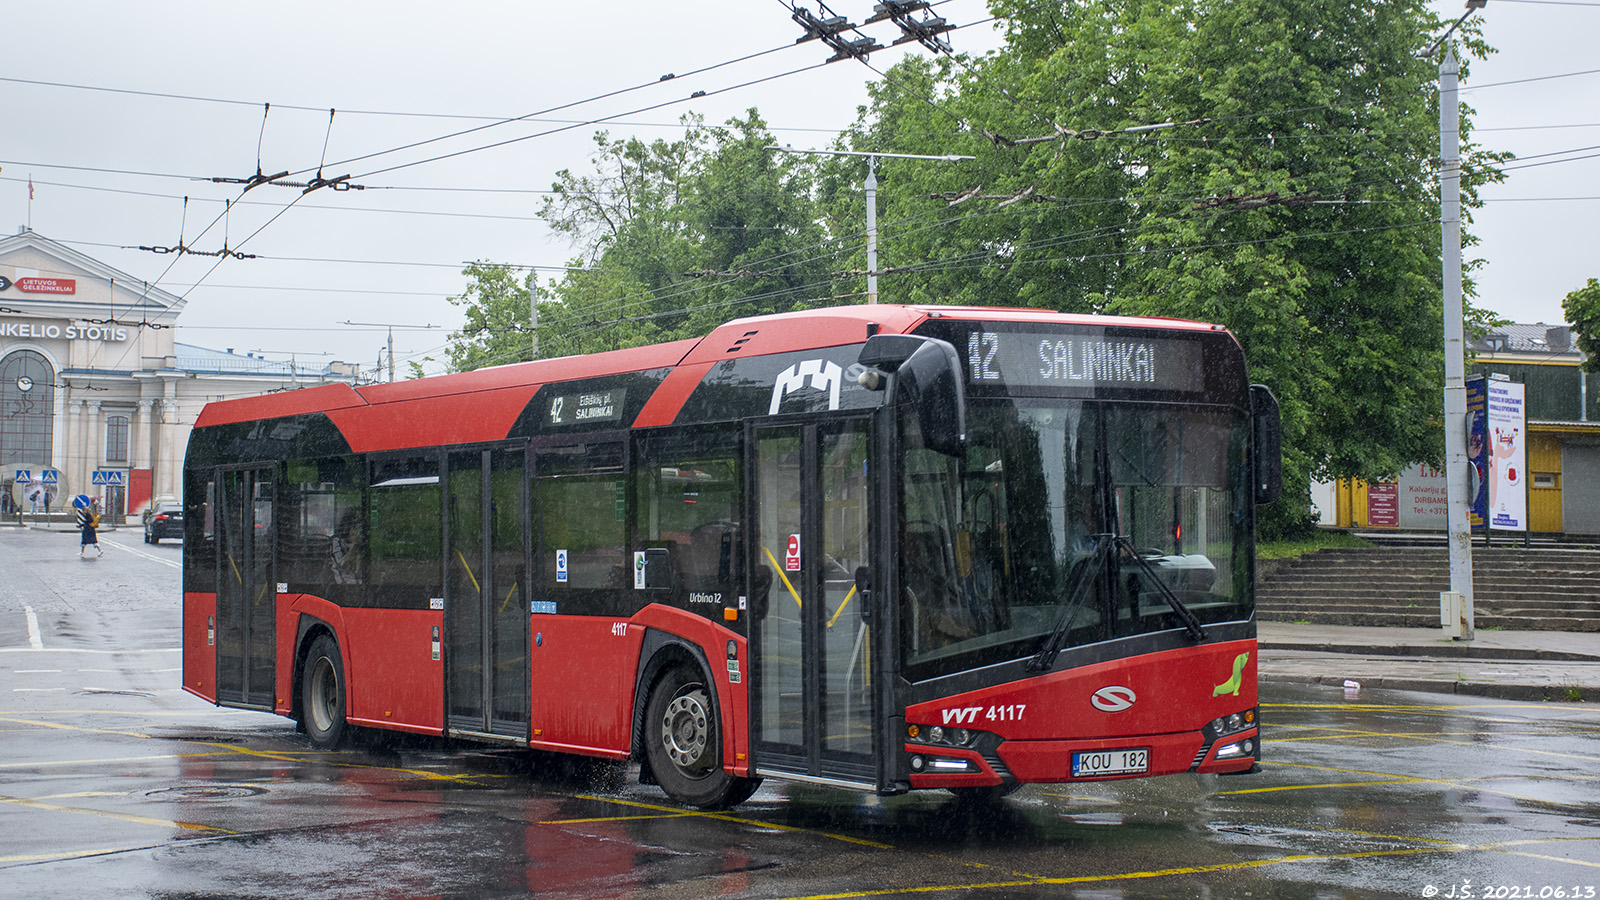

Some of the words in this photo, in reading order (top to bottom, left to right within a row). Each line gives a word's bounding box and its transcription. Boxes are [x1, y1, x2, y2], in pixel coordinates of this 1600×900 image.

[23, 284, 73, 292] GELEŽINKELIAI
[65, 325, 127, 341] STOTIS
[968, 332, 999, 379] 42
[1039, 339, 1155, 382] SALININKAI
[551, 397, 564, 424] 42
[1409, 485, 1440, 495] Kalvarijų
[1414, 496, 1447, 505] DIRBAME
[1413, 506, 1427, 514] Tel.:
[689, 592, 713, 603] Urbino
[714, 593, 722, 604] 12
[611, 622, 627, 636] 4117
[985, 704, 1026, 721] 4117
[1081, 754, 1112, 770] KOU
[1122, 752, 1146, 768] 182
